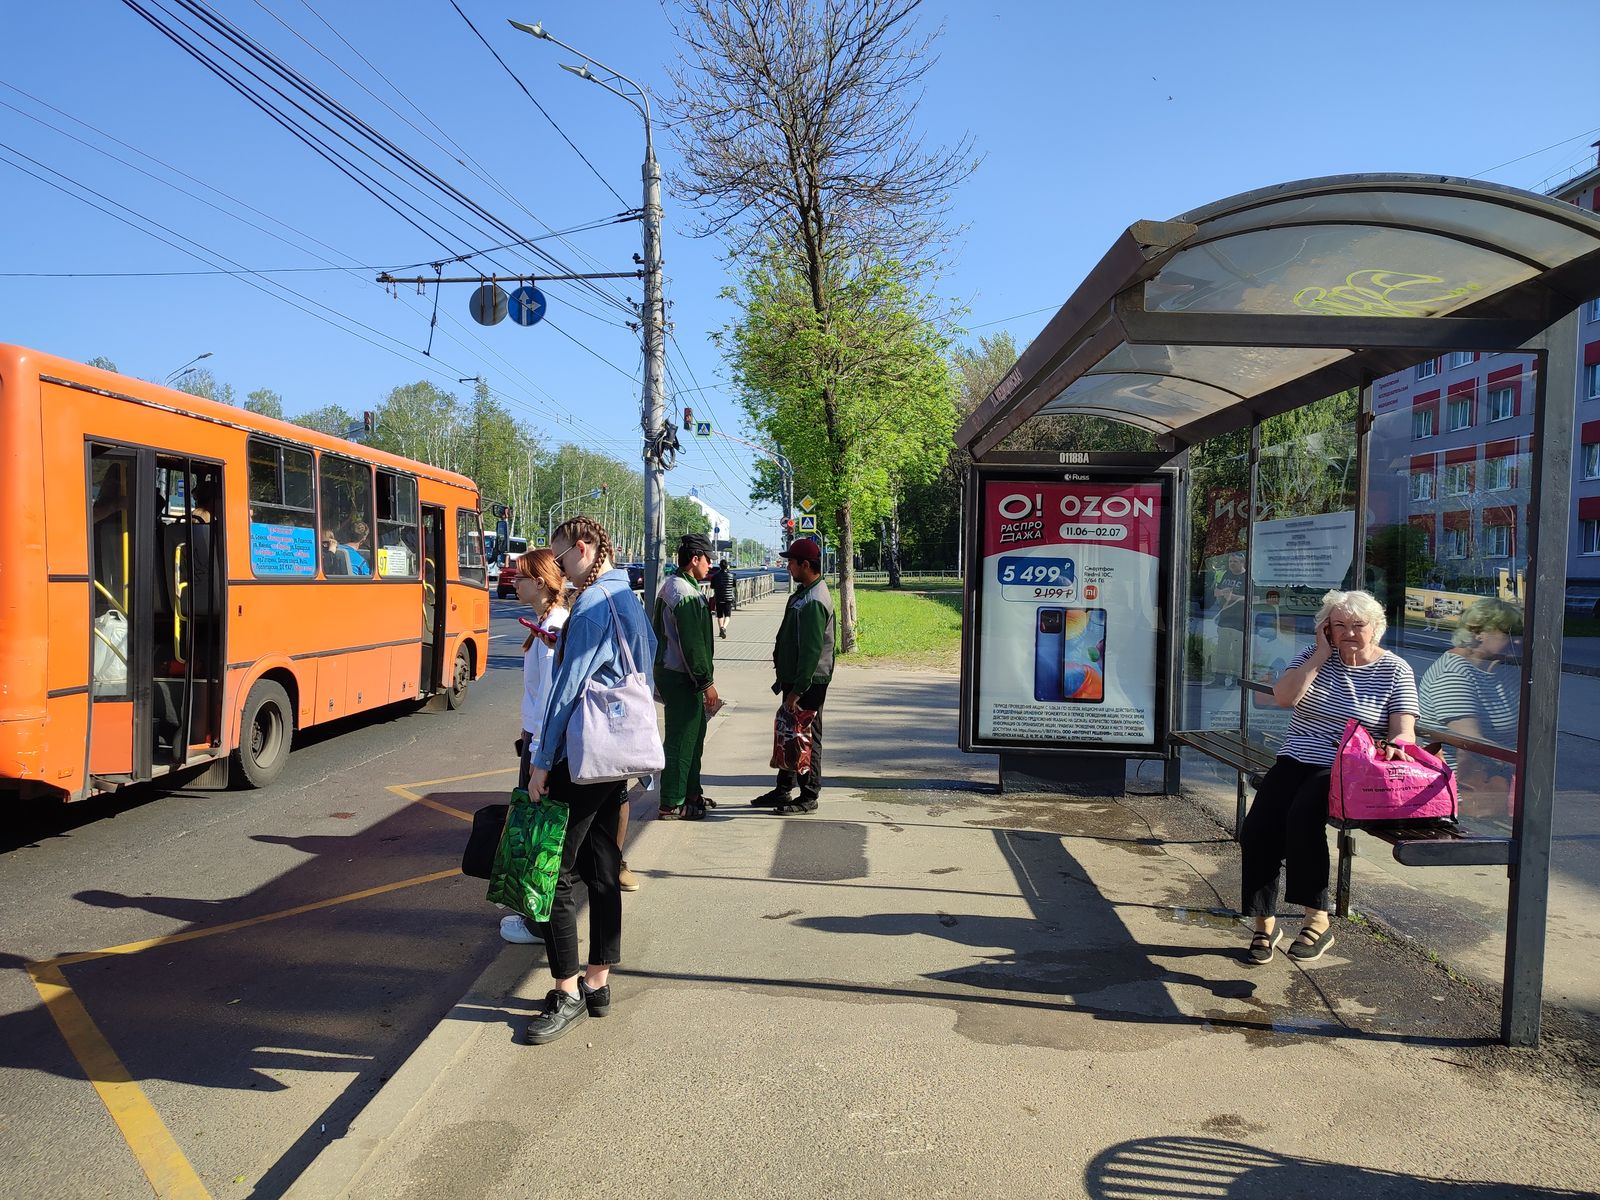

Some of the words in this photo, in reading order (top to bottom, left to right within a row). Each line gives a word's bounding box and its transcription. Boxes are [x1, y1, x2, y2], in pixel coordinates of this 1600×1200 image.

[1060, 495, 1153, 518] OZON
[1000, 520, 1042, 533] РАСПРО
[1000, 530, 1042, 543] ДАЖА
